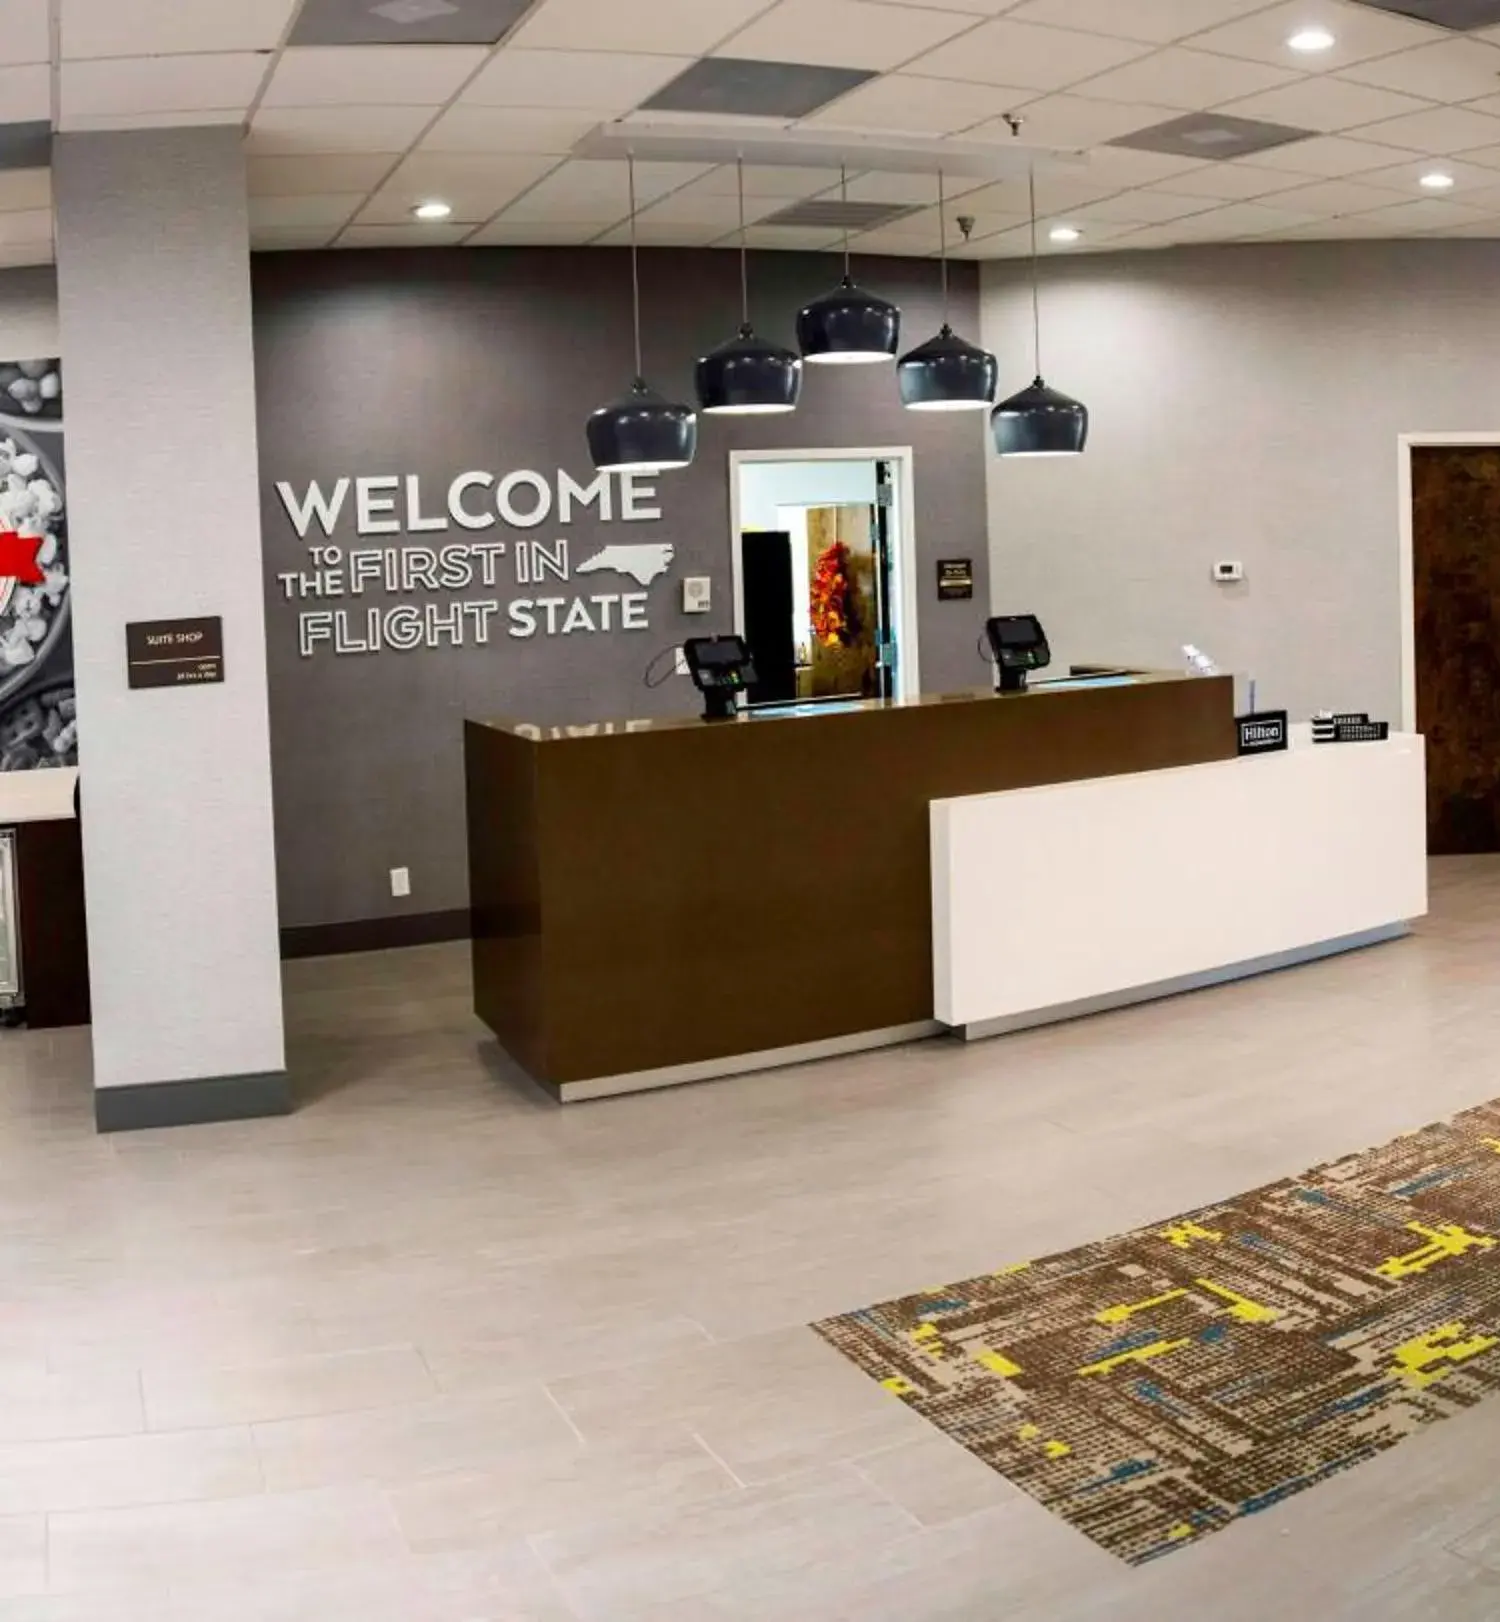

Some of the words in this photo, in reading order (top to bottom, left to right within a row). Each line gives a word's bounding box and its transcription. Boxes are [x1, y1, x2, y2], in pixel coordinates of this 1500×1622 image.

[274, 468, 663, 538] WELCOME
[278, 568, 345, 598] THE
[348, 541, 505, 595] FIRST
[514, 538, 570, 584] IN
[308, 545, 341, 566] TO
[146, 632, 173, 645] SUITE
[176, 631, 204, 643] SHOP
[299, 600, 499, 657] FLIGHT
[506, 592, 650, 639] STATE
[1244, 725, 1279, 741] Hilton
